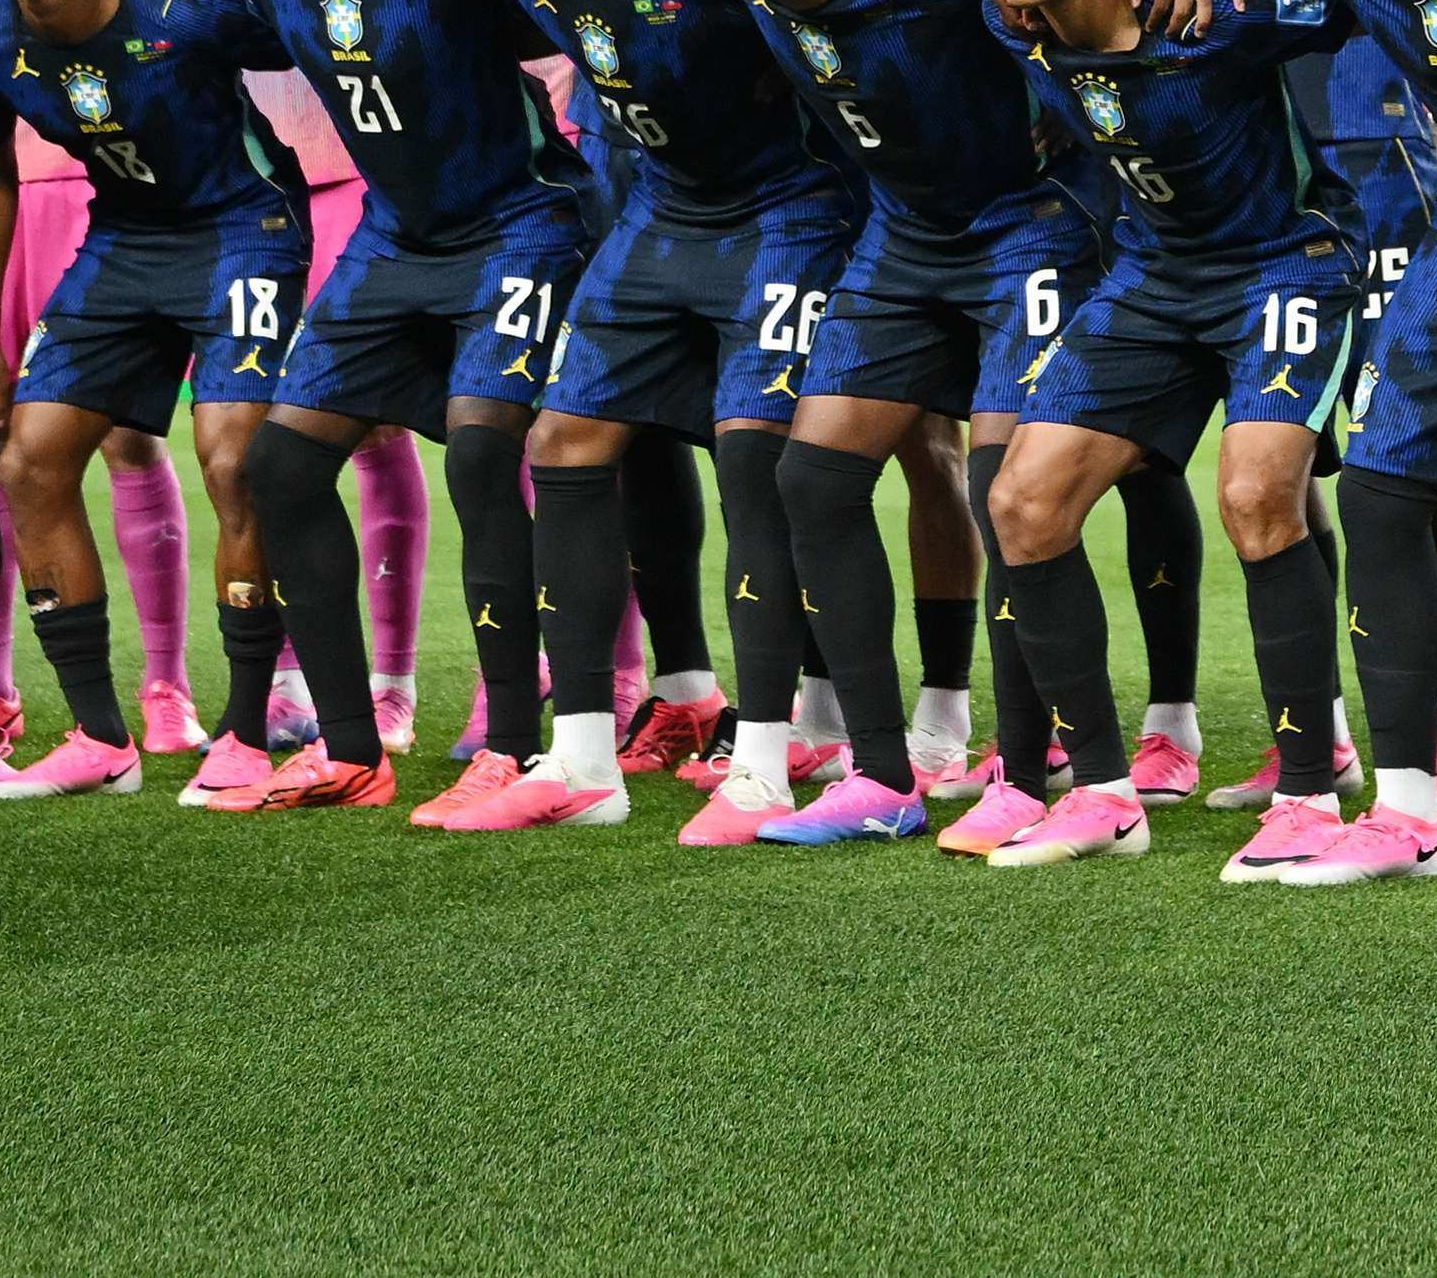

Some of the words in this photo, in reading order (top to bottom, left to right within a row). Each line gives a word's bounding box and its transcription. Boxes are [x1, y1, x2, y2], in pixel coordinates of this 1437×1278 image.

[331, 50, 372, 62] BRASIL
[592, 74, 633, 89] BRASIL
[80, 121, 124, 134] BRASIL
[336, 75, 402, 133] 21
[94, 140, 157, 184] 18
[1109, 157, 1175, 205] 16
[227, 277, 279, 340] 18
[495, 276, 552, 343] 21
[1026, 269, 1060, 337] 6
[1262, 294, 1317, 355] 16
